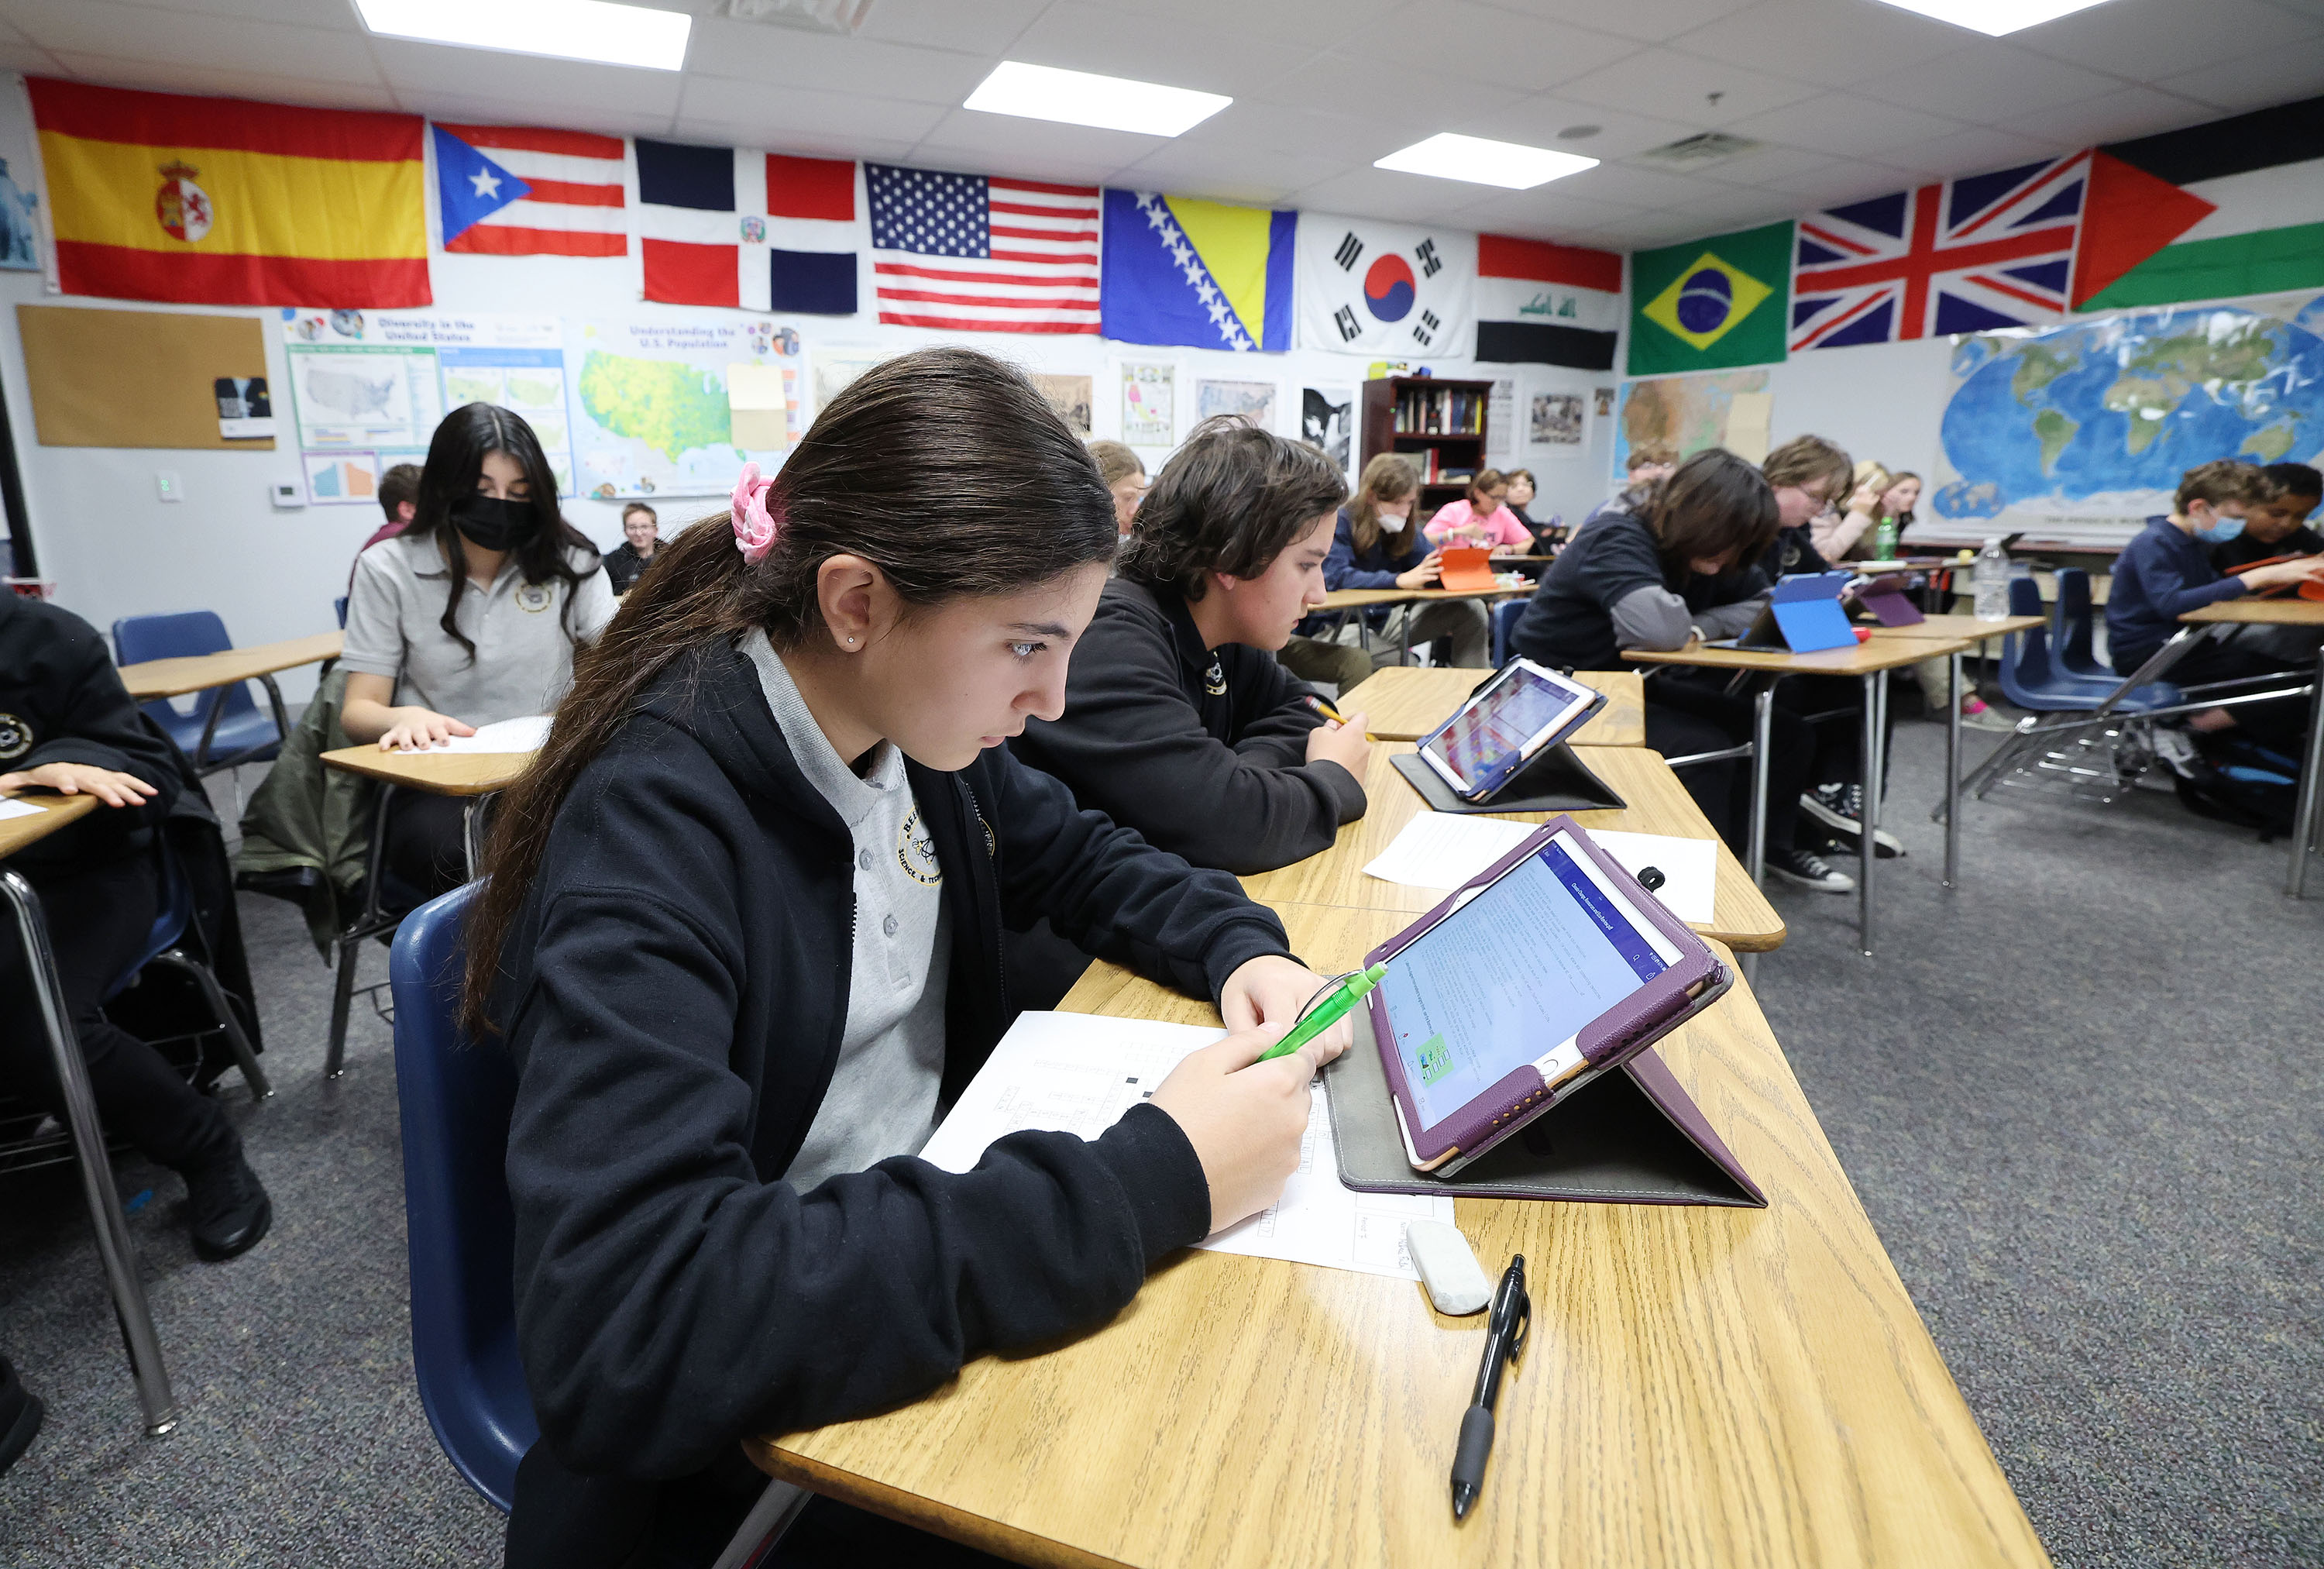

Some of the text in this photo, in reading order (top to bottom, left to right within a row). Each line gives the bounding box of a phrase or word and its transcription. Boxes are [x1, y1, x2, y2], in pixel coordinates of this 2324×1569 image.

[378, 316, 475, 329] Diversity in the
[385, 331, 471, 342] United States
[629, 325, 735, 338] Understanding the
[639, 338, 728, 349] U.S. Population
[899, 848, 916, 878] SCIENCE
